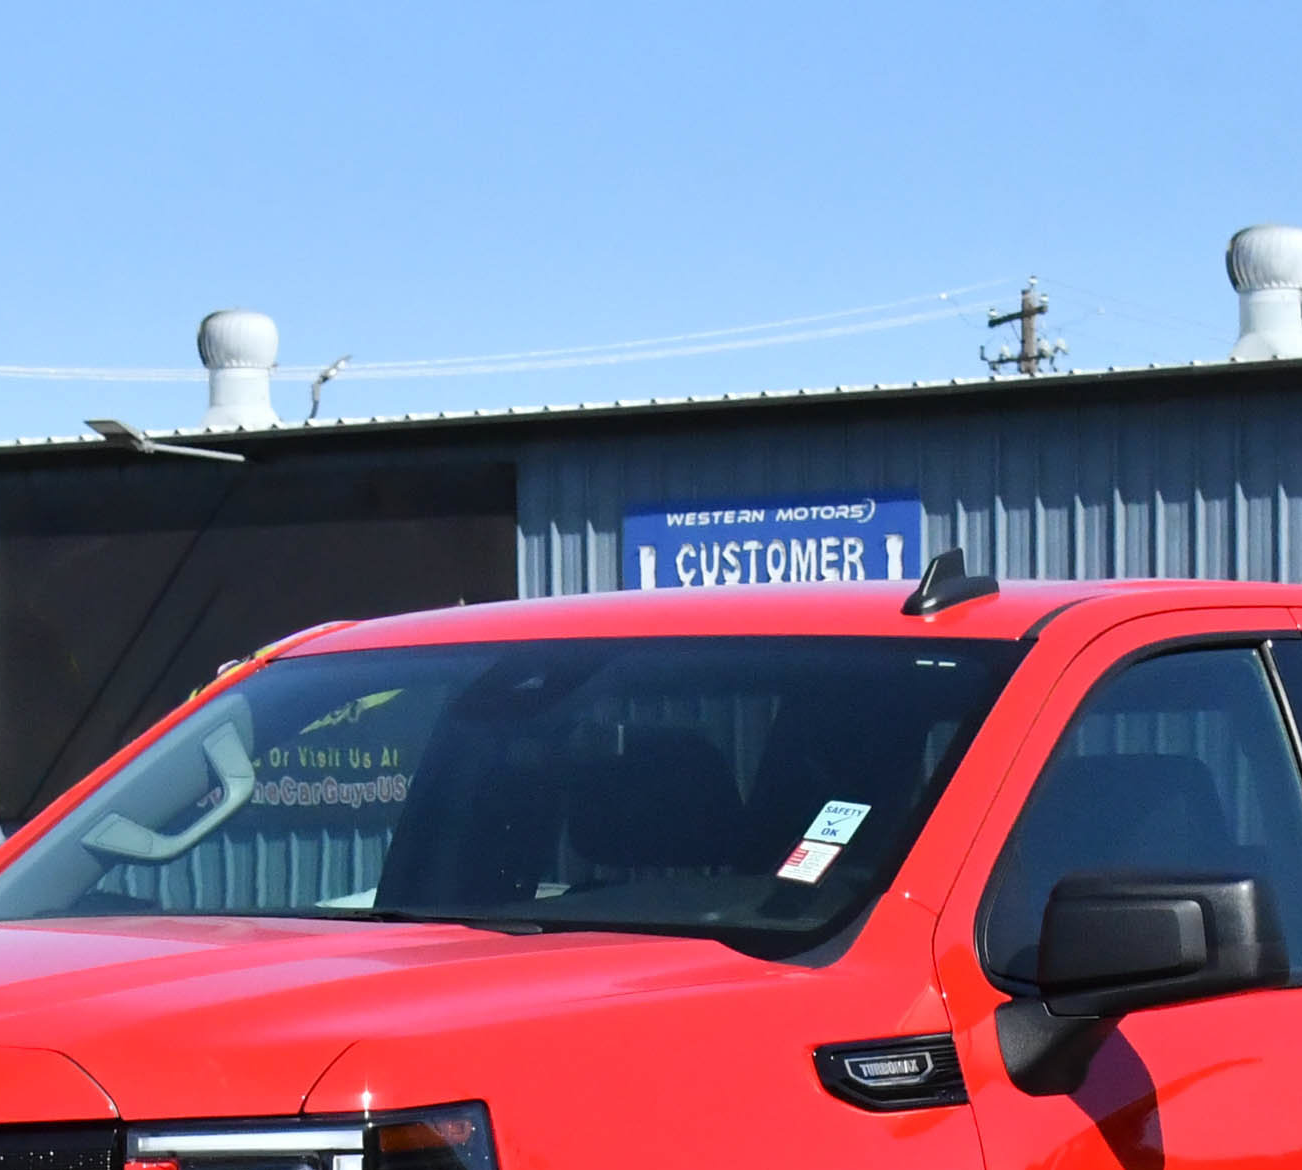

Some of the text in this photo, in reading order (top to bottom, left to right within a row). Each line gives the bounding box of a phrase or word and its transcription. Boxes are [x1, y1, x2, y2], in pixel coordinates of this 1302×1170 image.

[666, 504, 864, 528] WESTERN MOTORS
[676, 536, 865, 587] CUSTOMER
[269, 746, 290, 767] Or
[348, 747, 372, 768] Us
[824, 806, 864, 817] SAFETY
[821, 827, 839, 837] OK
